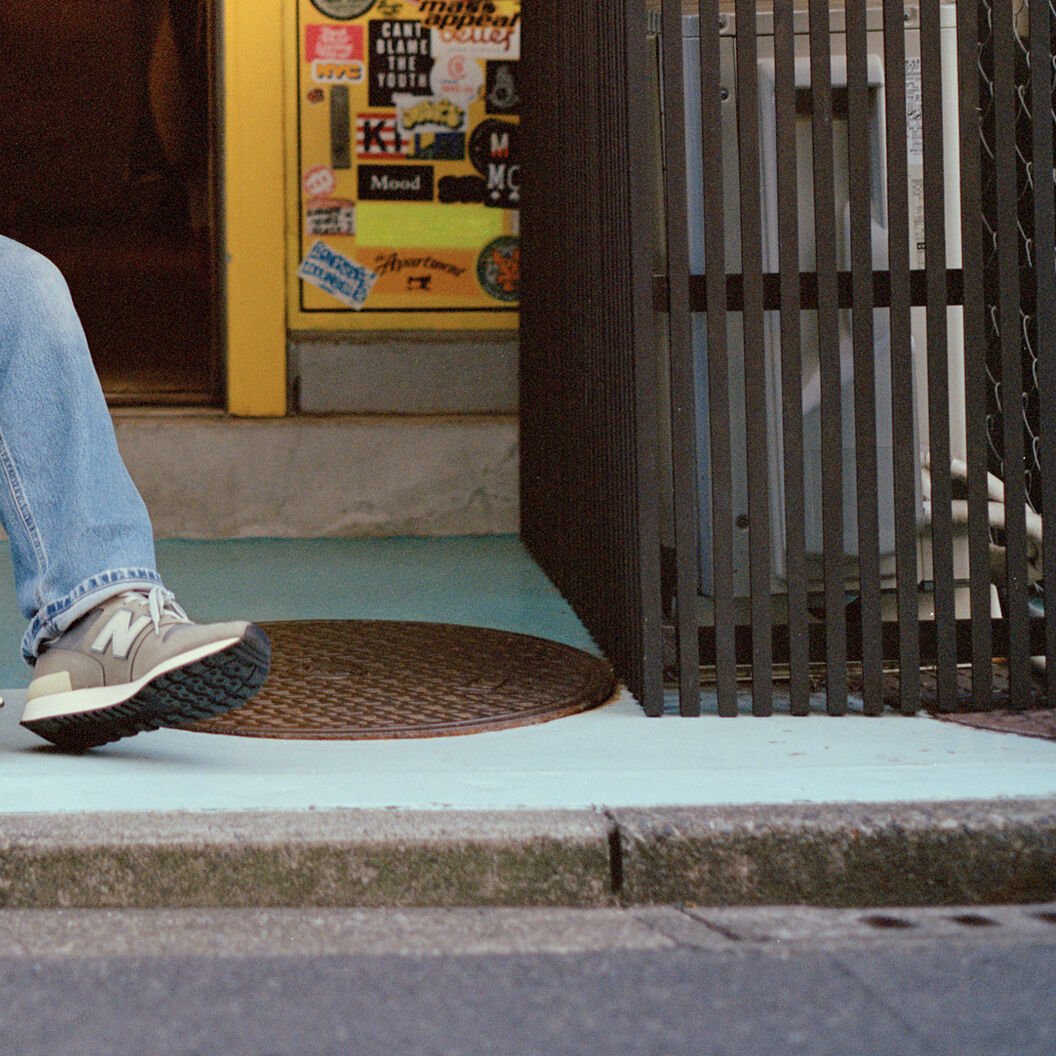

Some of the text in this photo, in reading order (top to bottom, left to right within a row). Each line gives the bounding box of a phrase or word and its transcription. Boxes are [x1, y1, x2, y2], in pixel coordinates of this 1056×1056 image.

[375, 39, 428, 55] BLAME
[388, 55, 416, 71] THE
[378, 72, 427, 88] YOUTH
[370, 175, 421, 191] Mood
[375, 251, 466, 277] Apartment
[90, 608, 152, 660] N
